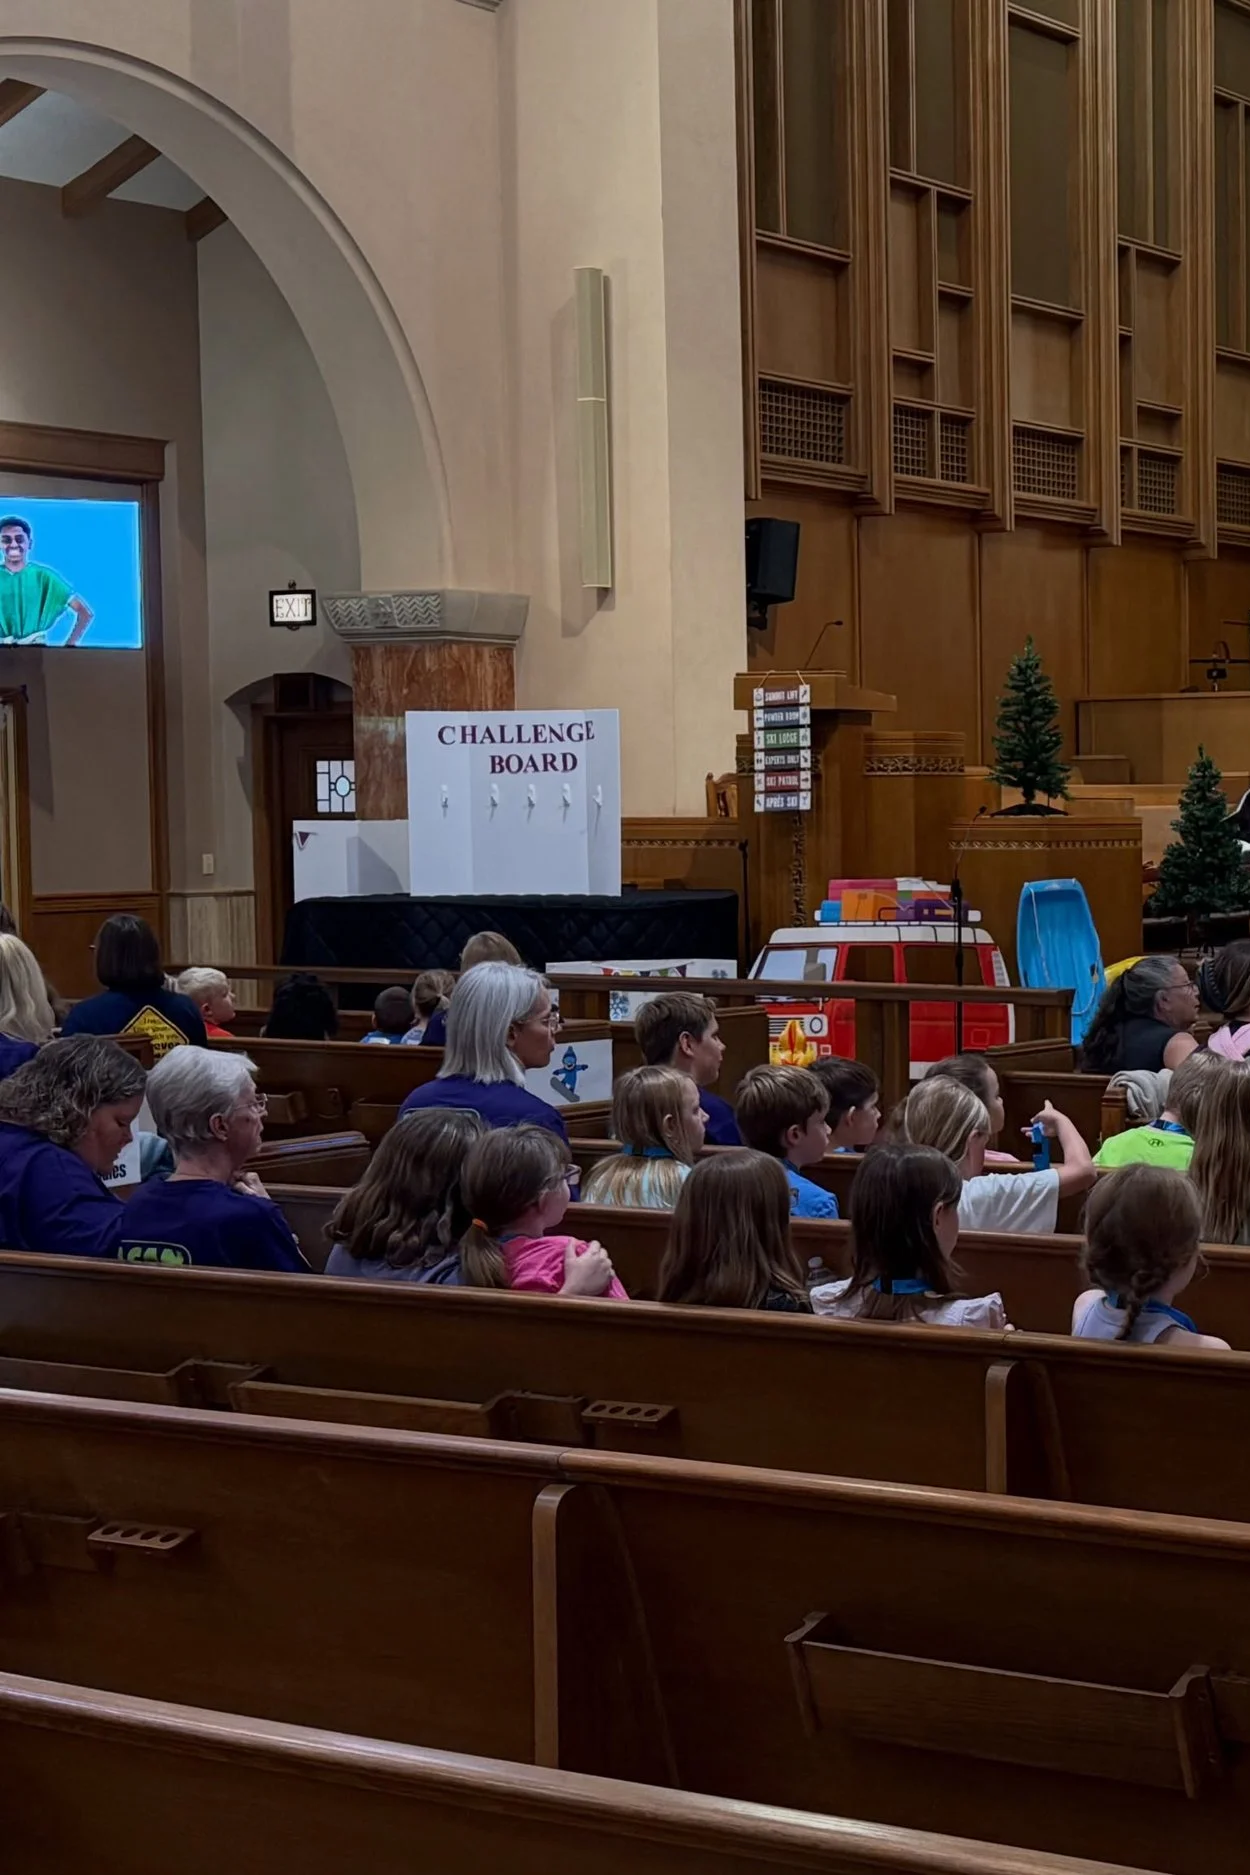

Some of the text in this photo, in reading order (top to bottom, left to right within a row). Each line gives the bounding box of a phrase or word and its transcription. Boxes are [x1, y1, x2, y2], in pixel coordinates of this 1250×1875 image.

[275, 597, 311, 618] EXIT
[787, 690, 798, 700] LIFT
[437, 720, 596, 746] CHALLENGE
[766, 732, 798, 745] SKI LODGE
[489, 752, 578, 775] BOARD
[765, 754, 800, 765] EXPERTS ONLY
[766, 775, 799, 787] SKI PATROL
[786, 796, 798, 807] SKI
